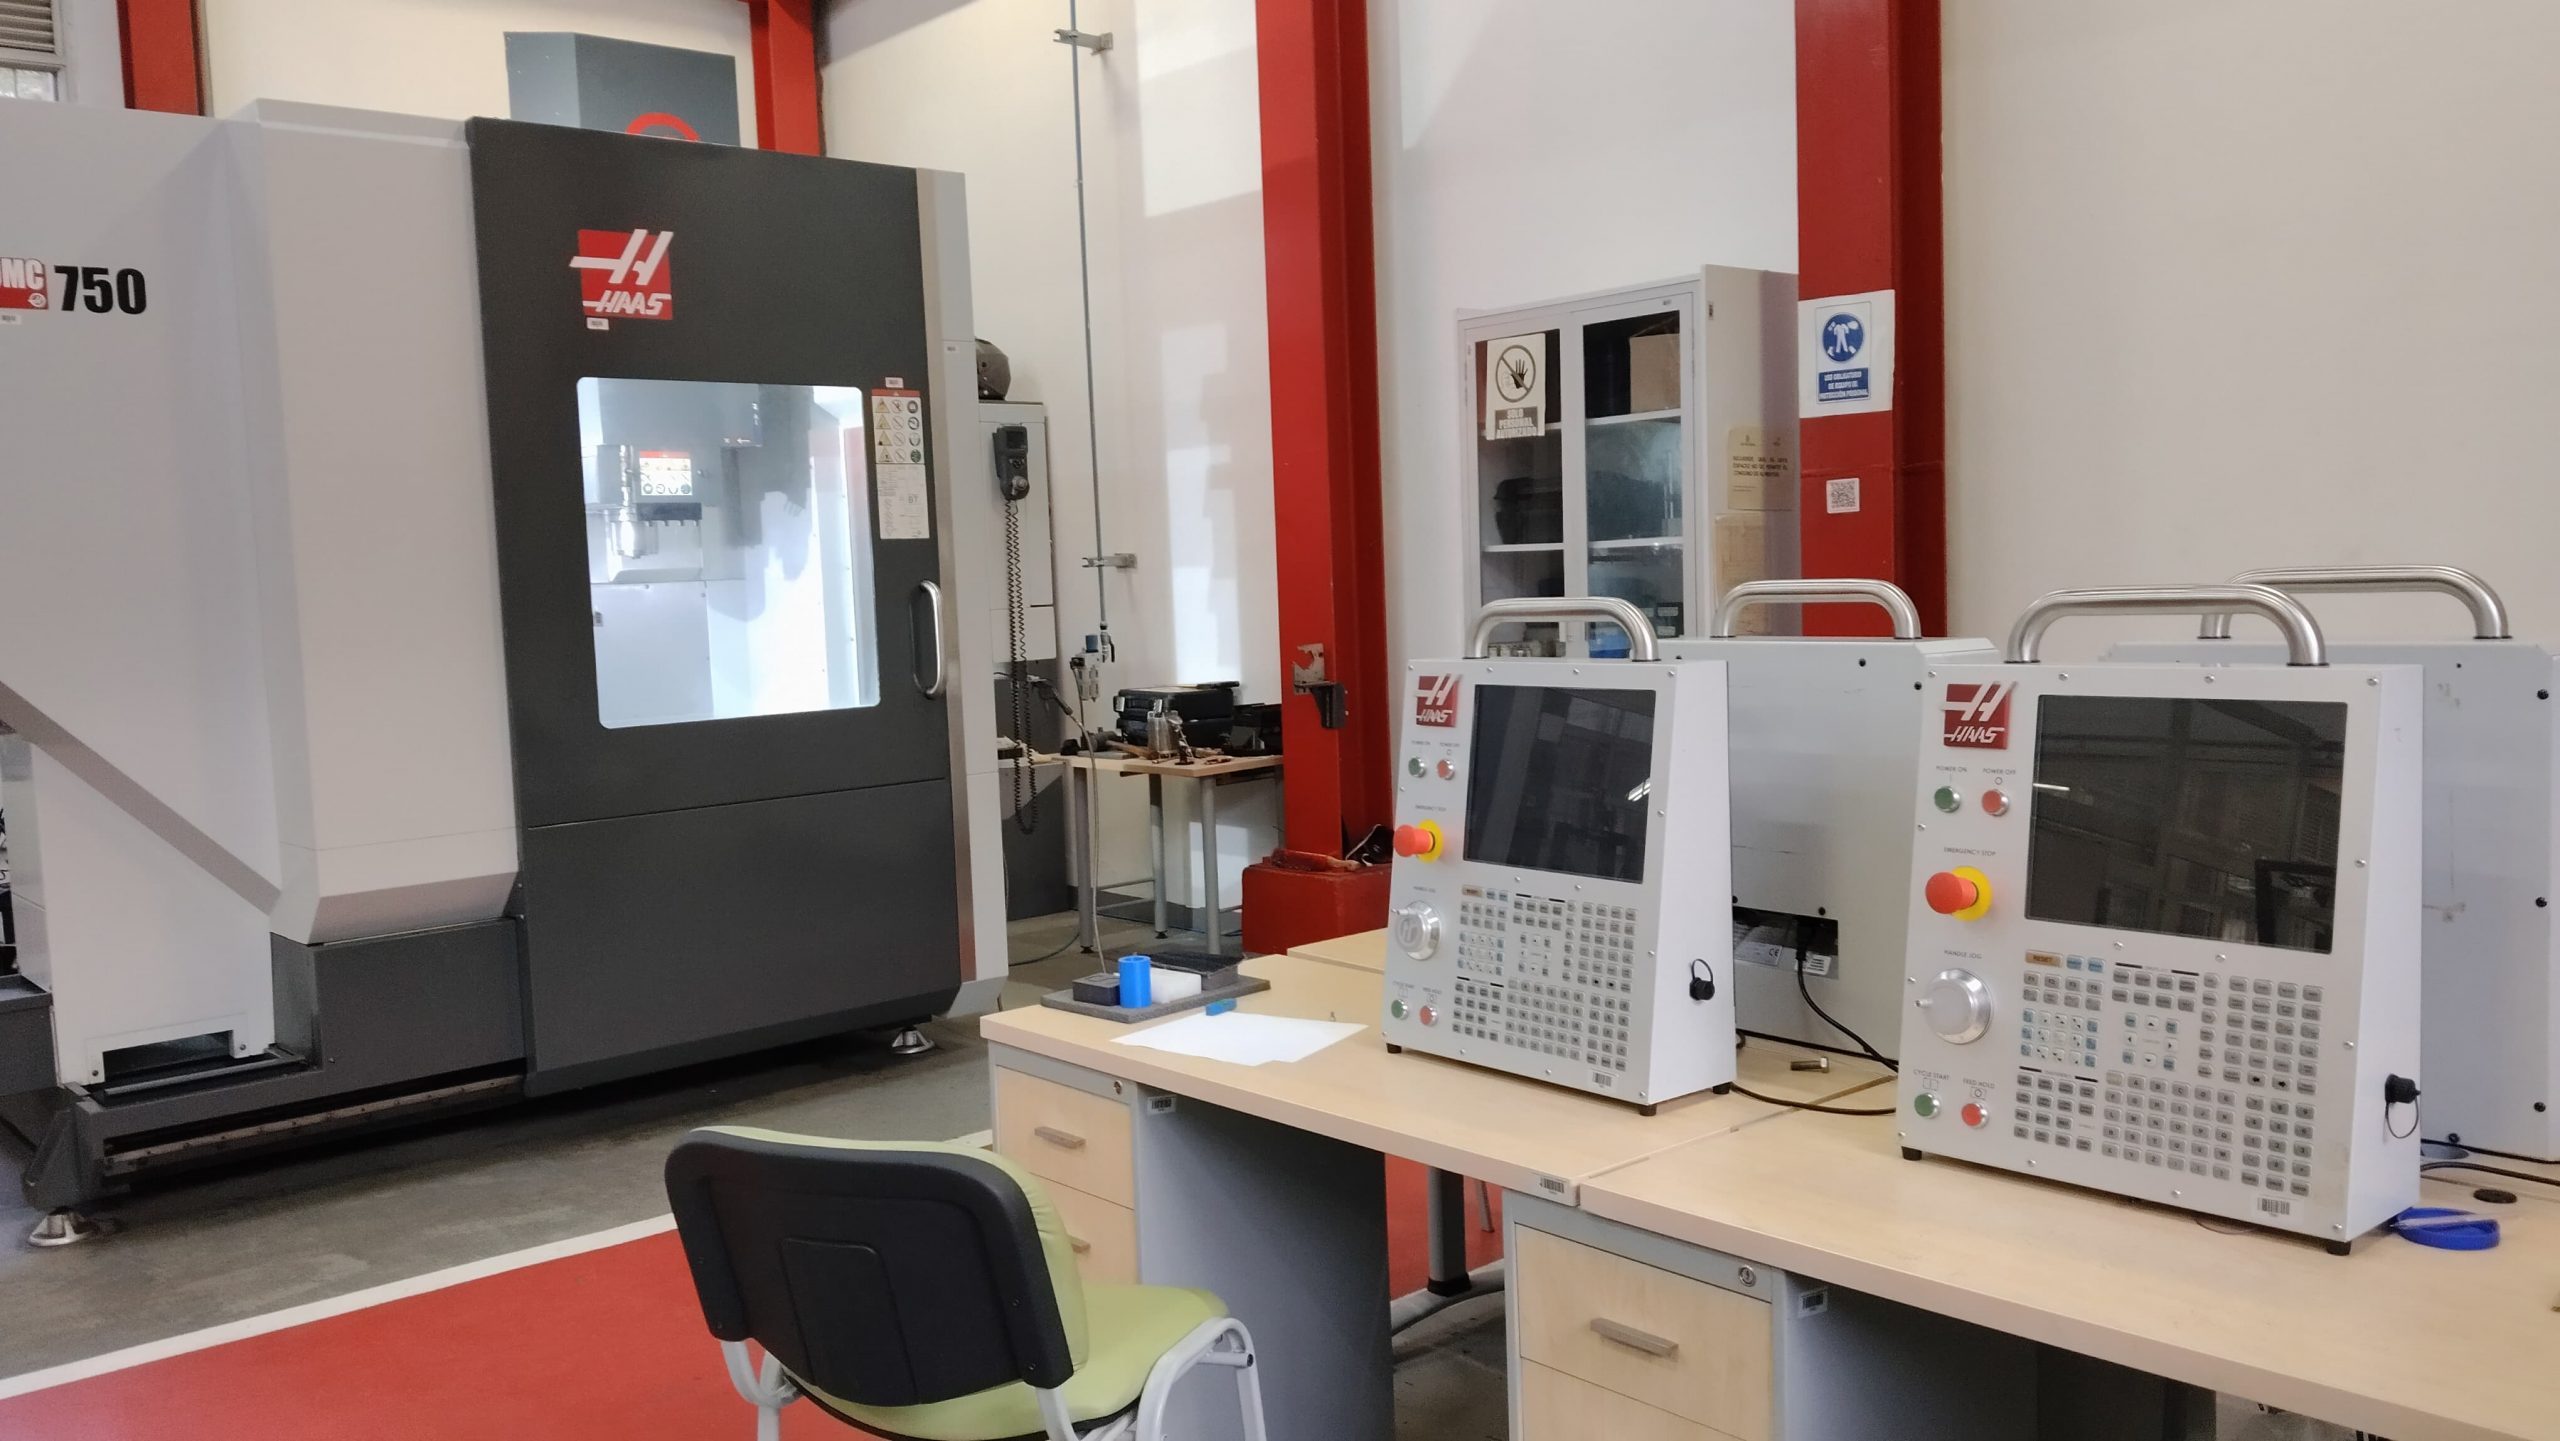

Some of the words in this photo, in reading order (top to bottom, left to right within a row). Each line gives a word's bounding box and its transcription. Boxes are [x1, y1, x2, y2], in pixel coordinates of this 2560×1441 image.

[0, 256, 46, 290] MC
[54, 265, 147, 315] 750
[583, 290, 672, 315] HAAS
[1416, 709, 1453, 723] HAAS
[1944, 725, 2005, 744] HAAS
[1936, 765, 1956, 773] POWER
[1943, 846, 1980, 855] EMERGENCY
[1981, 849, 1996, 857] STOP
[1944, 950, 1967, 958] HANDLE
[2033, 954, 2053, 963] RESET
[1913, 1068, 1932, 1077] CYCLE
[1933, 1072, 1950, 1081] START
[1963, 1077, 1977, 1086] FEED
